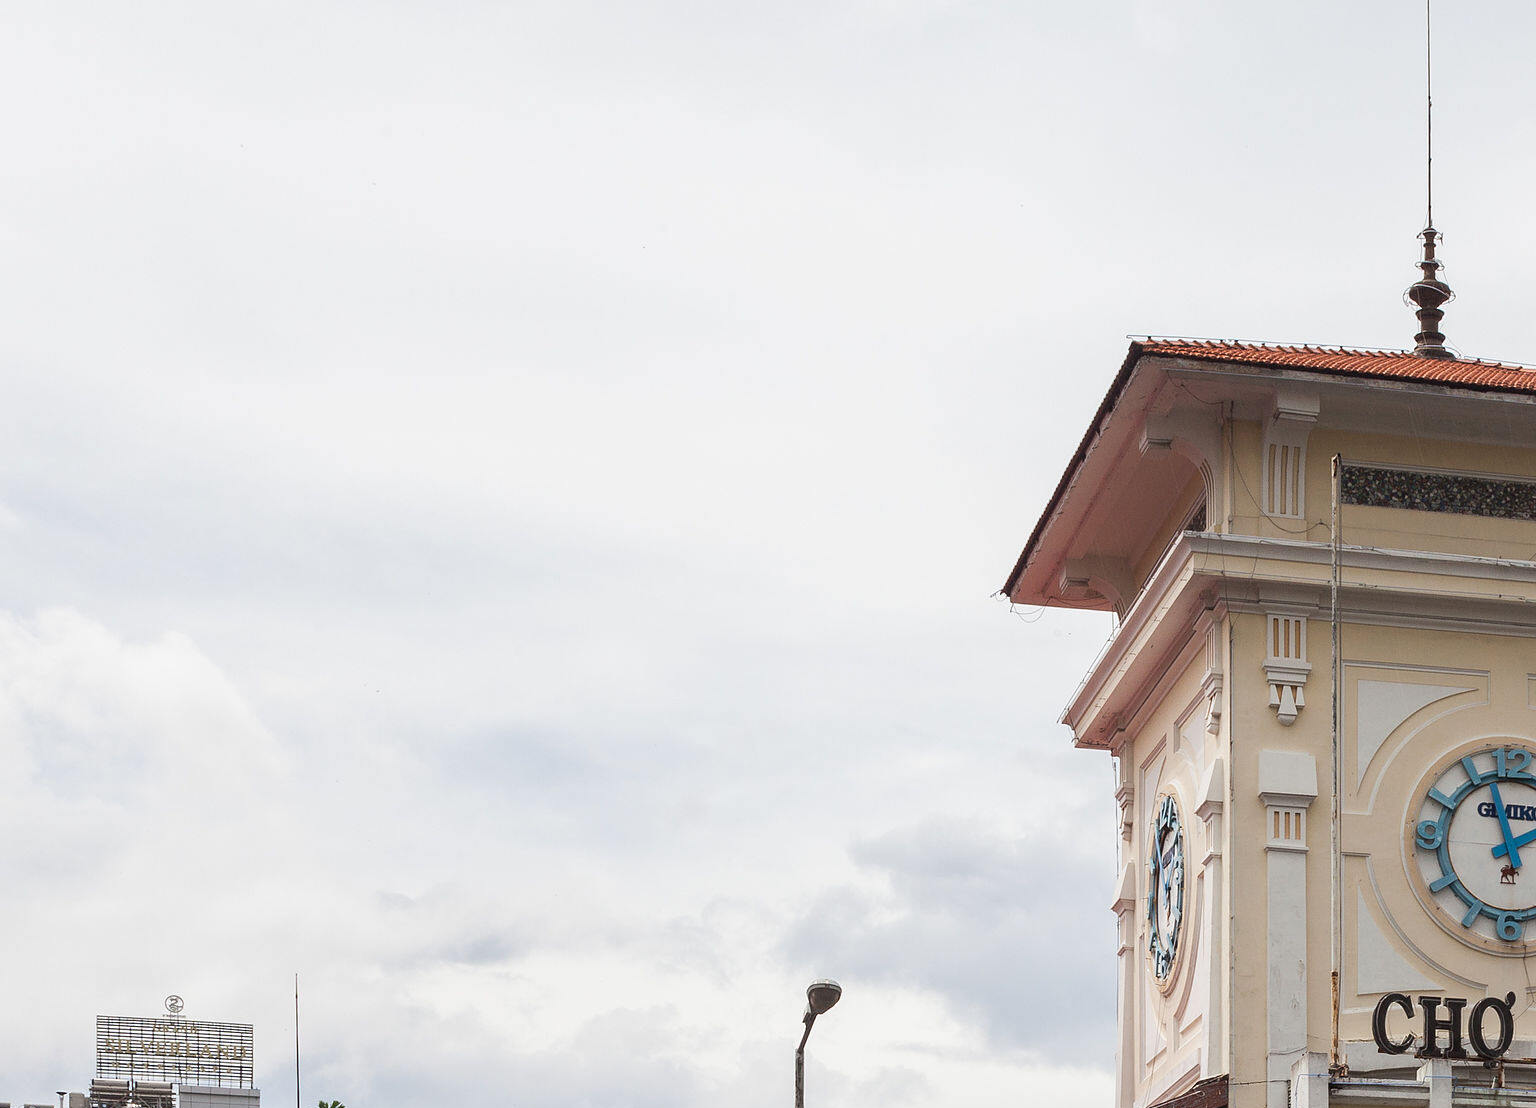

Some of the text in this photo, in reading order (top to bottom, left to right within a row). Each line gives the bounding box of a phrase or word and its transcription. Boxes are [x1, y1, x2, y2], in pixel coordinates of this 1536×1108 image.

[1492, 748, 1533, 779] 12
[1416, 820, 1443, 850] 9
[1496, 911, 1522, 941] 6
[104, 1038, 246, 1060] SILVERLAND
